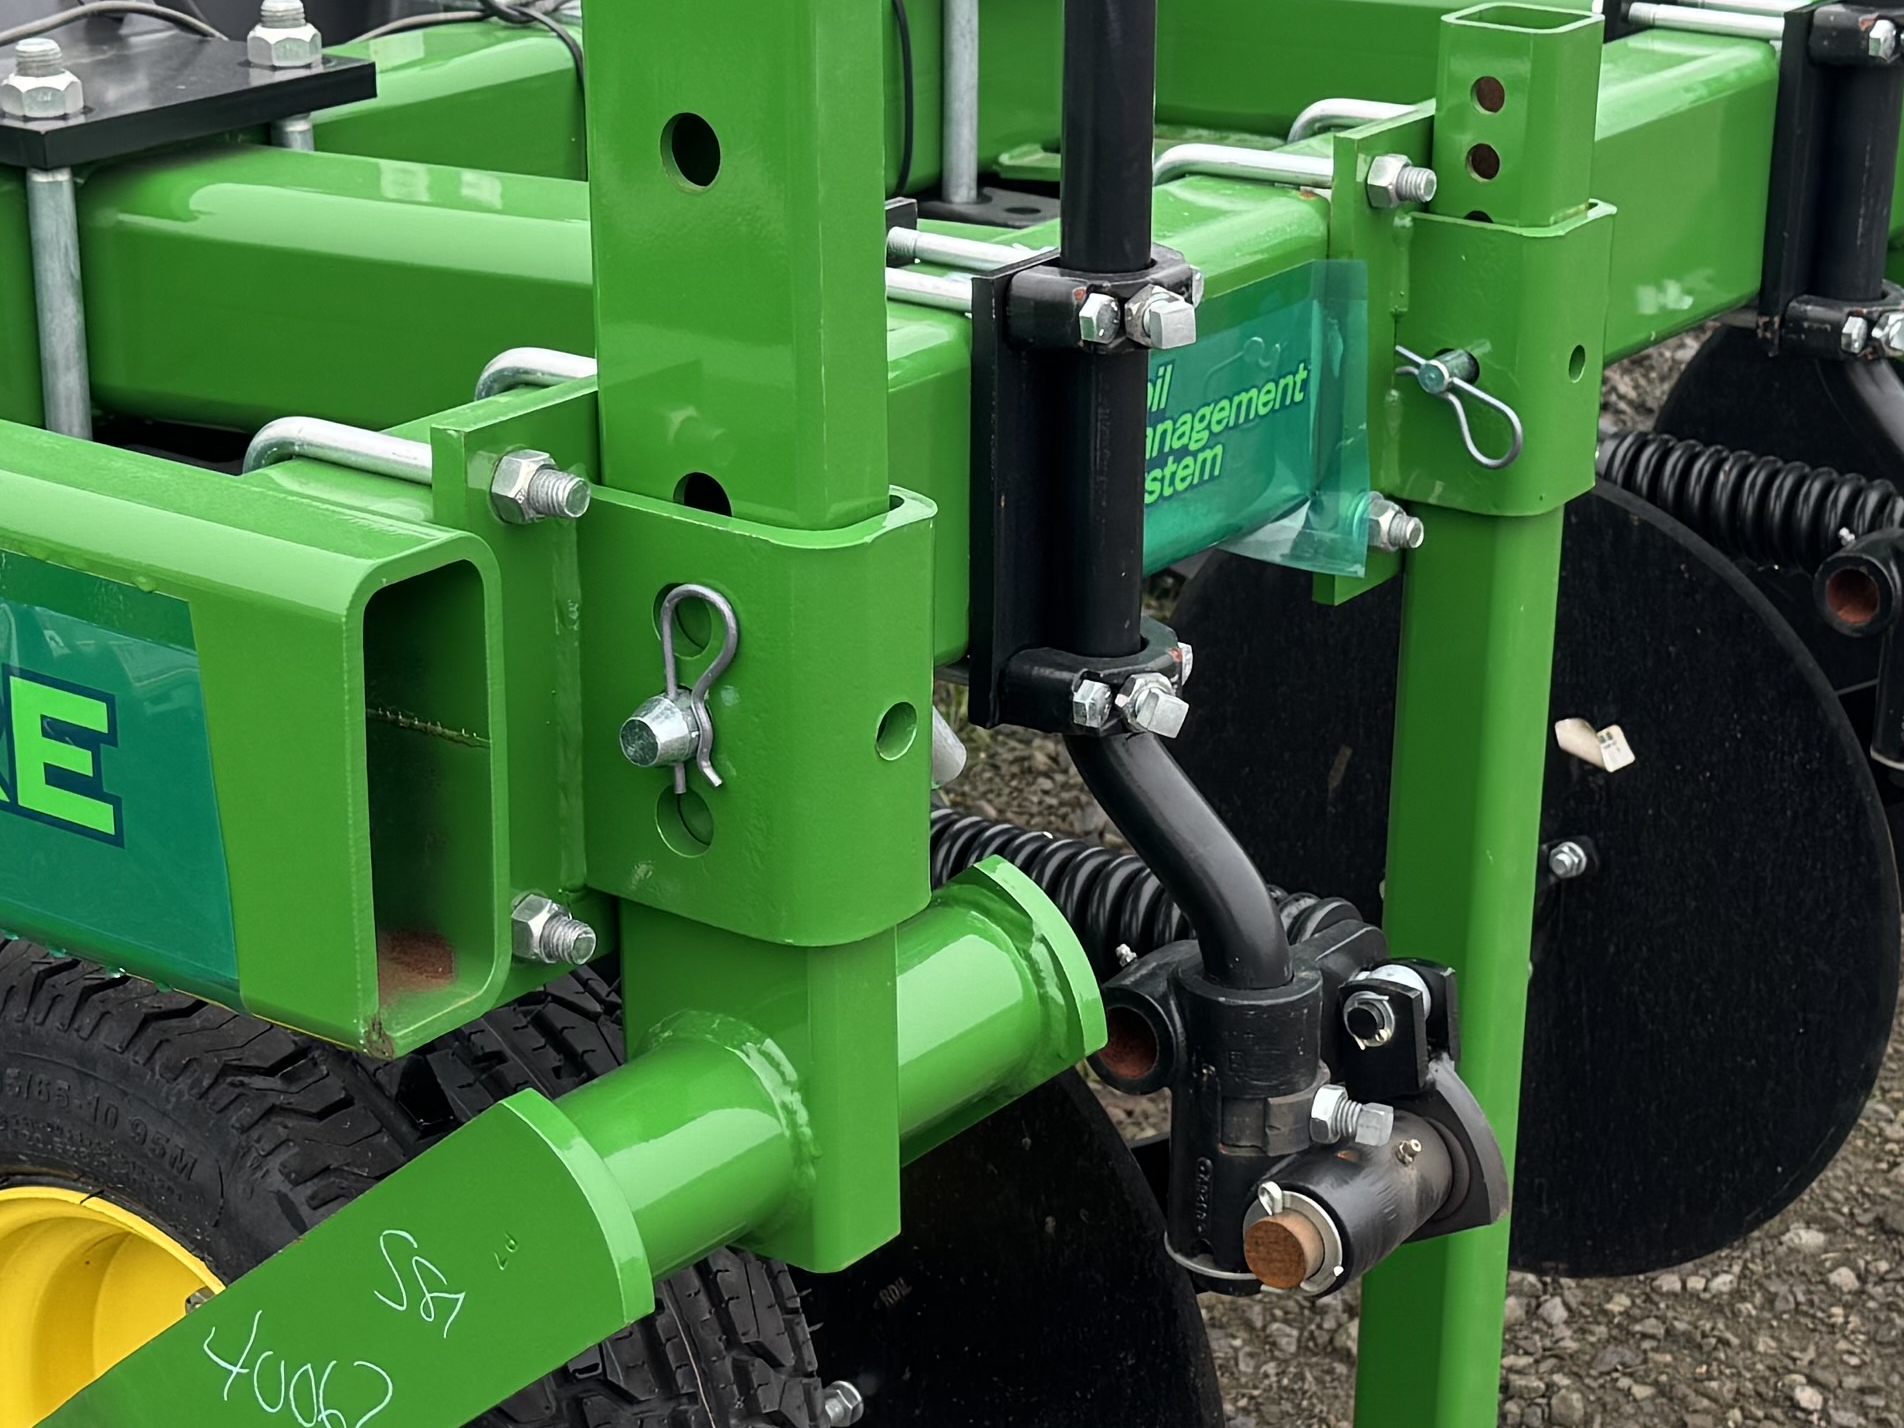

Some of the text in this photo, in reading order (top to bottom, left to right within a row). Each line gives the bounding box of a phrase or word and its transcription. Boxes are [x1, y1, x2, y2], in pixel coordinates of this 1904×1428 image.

[1145, 362, 1308, 460] nagement
[1147, 363, 1173, 413] il
[1144, 443, 1224, 504] stem
